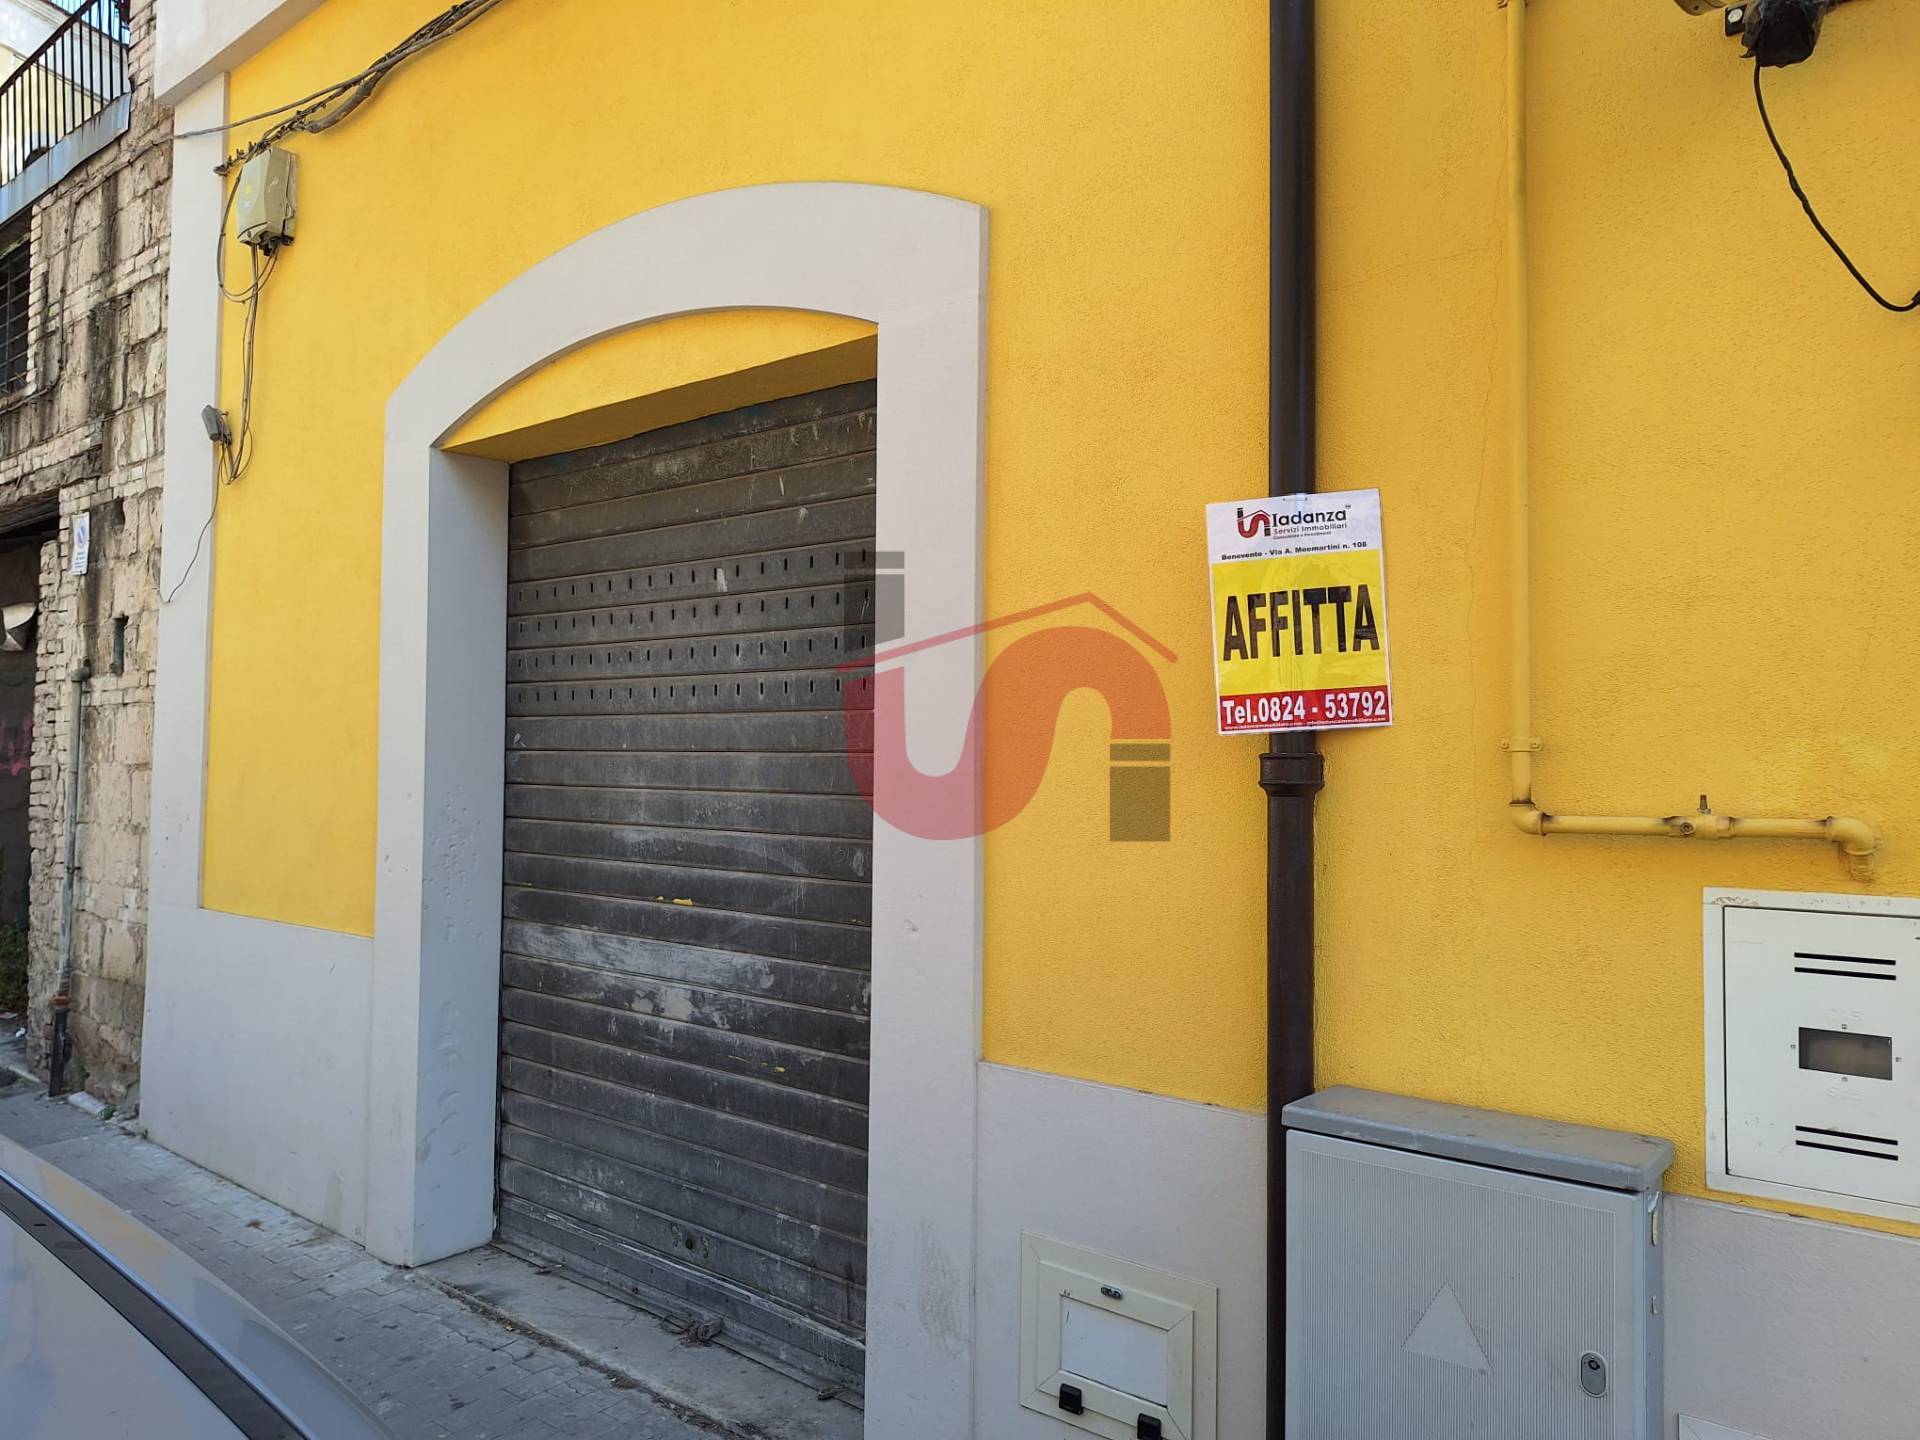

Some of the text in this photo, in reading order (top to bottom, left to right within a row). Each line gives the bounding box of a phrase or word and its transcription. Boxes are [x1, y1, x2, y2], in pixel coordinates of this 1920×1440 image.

[1272, 509, 1347, 528] Iadanza
[1273, 526, 1300, 535] Servizi
[1221, 551, 1263, 561] Benevento
[1295, 544, 1341, 553] Meomartini
[1223, 584, 1380, 661] AFFITTA
[1222, 695, 1306, 725] Tel.0824
[1325, 690, 1387, 719] 53792
